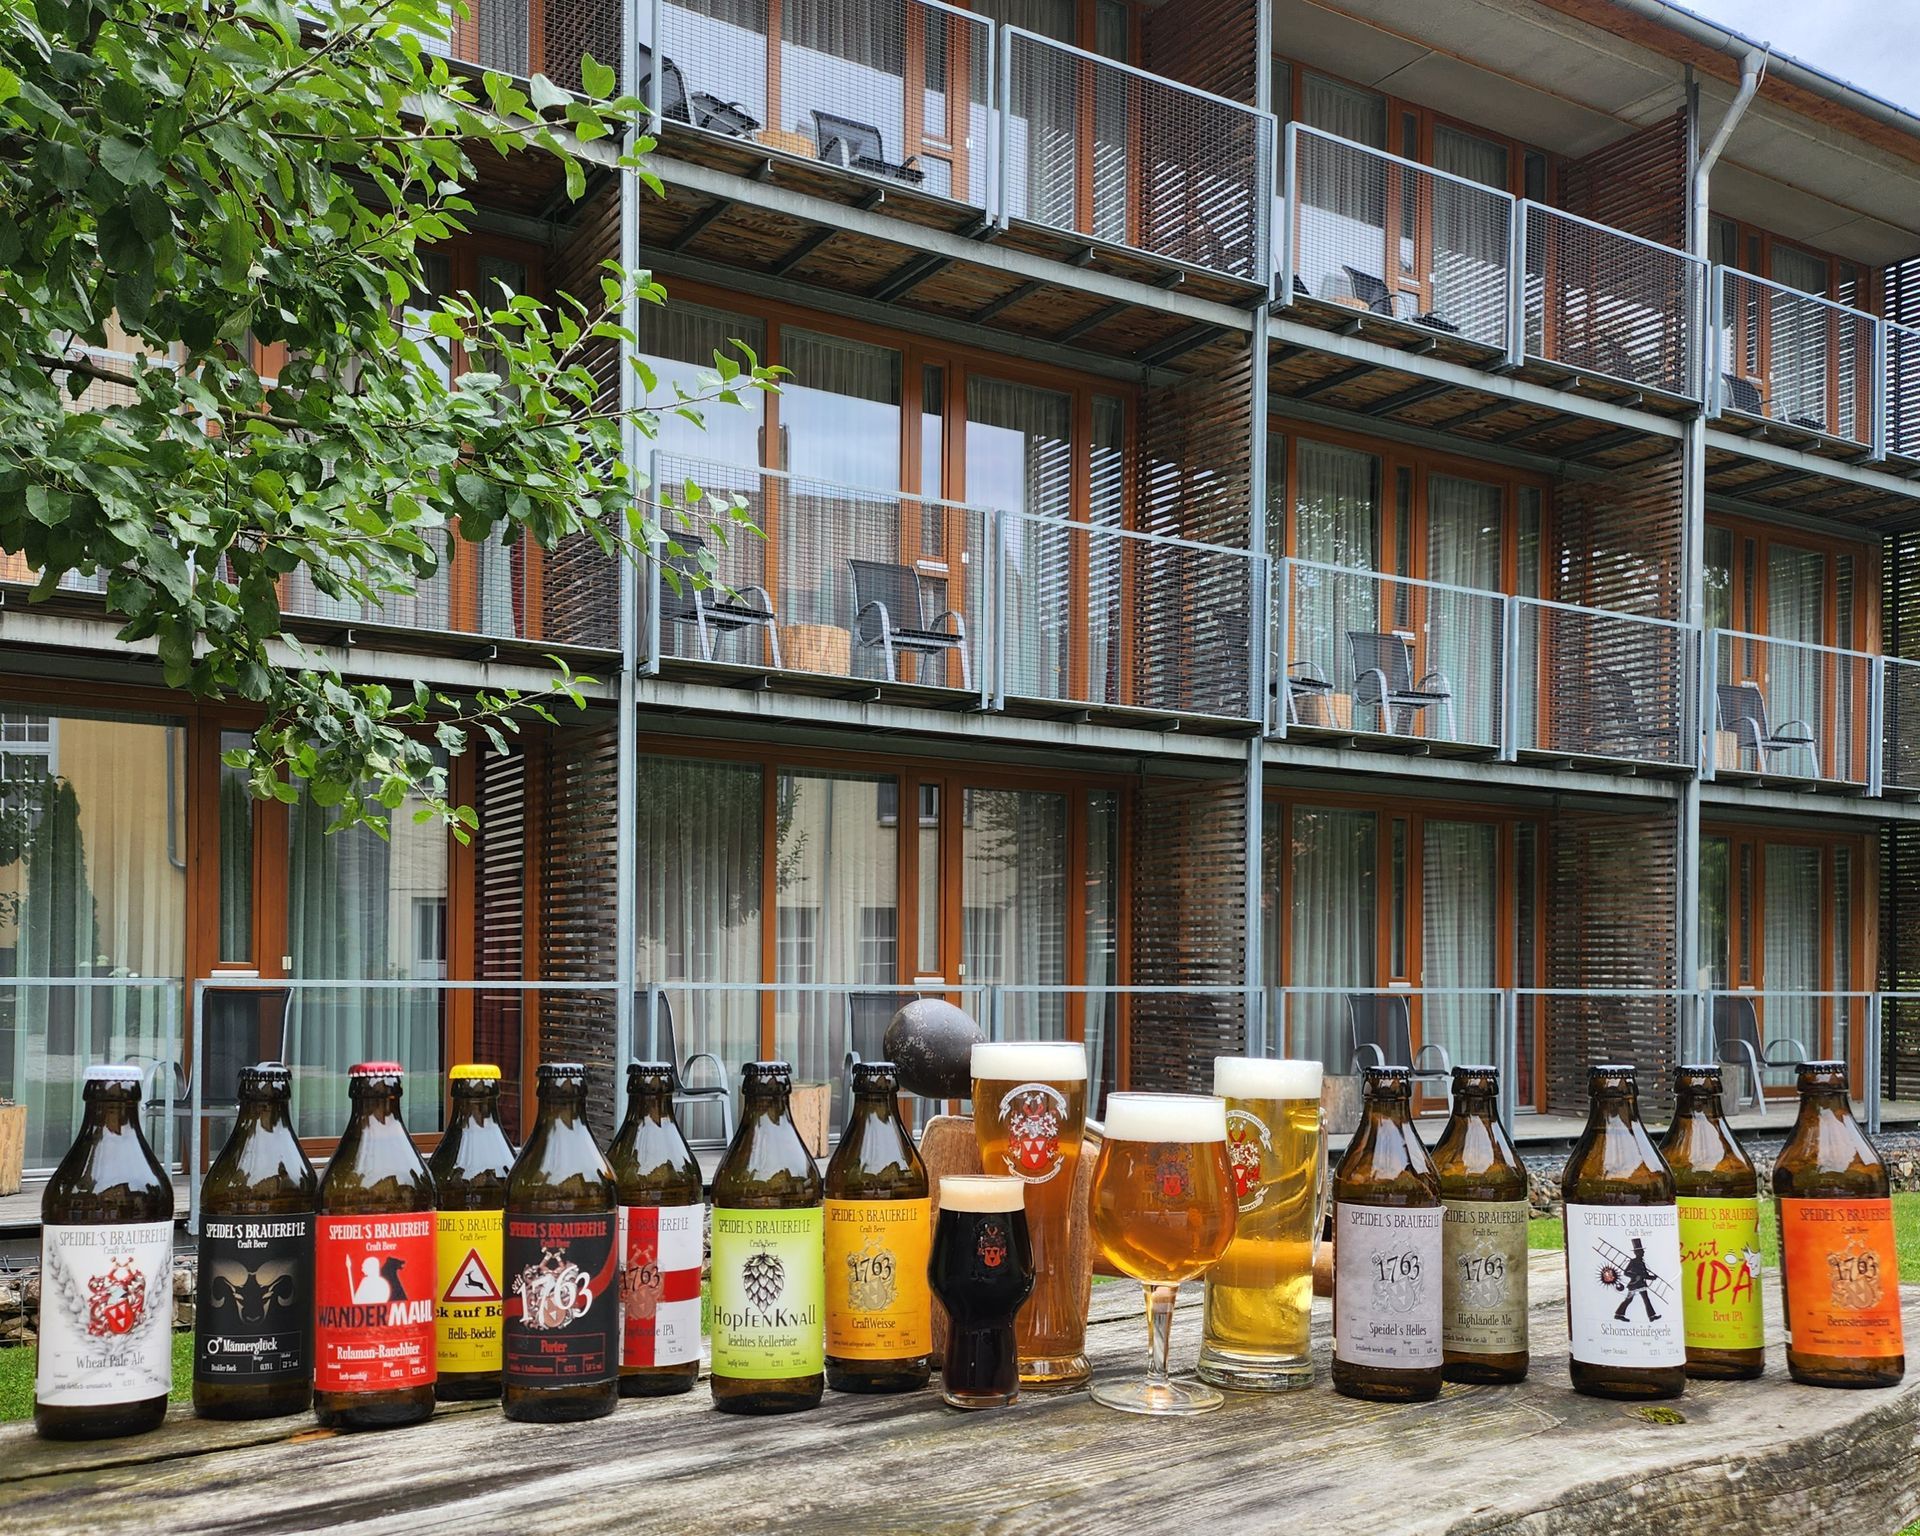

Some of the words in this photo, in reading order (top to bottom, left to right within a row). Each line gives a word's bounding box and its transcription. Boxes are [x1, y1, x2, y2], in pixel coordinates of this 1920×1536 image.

[831, 1208, 864, 1222] SPEIDEL'S
[1351, 1211, 1392, 1228] SPEIDEL'S
[1584, 1212, 1627, 1227] SPEIDEL'S
[205, 1223, 243, 1238] SPEIDEL'S
[329, 1224, 372, 1240] SPEIDEL'S
[718, 1219, 753, 1234] SPEIDEL'S
[60, 1231, 106, 1246] SPEIDEL'S
[237, 1240, 252, 1249] Craft
[253, 1240, 268, 1249] Beer
[852, 1252, 892, 1284] 1763
[1376, 1250, 1420, 1284] 1763
[1463, 1253, 1504, 1282] 1763
[1834, 1251, 1877, 1282] 1763
[620, 1262, 660, 1292] 1763
[1696, 1259, 1753, 1305] IPA
[517, 1264, 593, 1330] 1763
[453, 1306, 482, 1318] auf
[485, 1304, 503, 1317] Bö
[1501, 1314, 1513, 1326] Ale
[663, 1324, 675, 1336] IPA
[1405, 1324, 1427, 1336] Helles
[728, 1333, 756, 1347] leichtes
[758, 1334, 798, 1348] Kellerbier
[76, 1355, 107, 1368] Wheat
[109, 1353, 128, 1367] Pale
[131, 1351, 145, 1366] Ale
